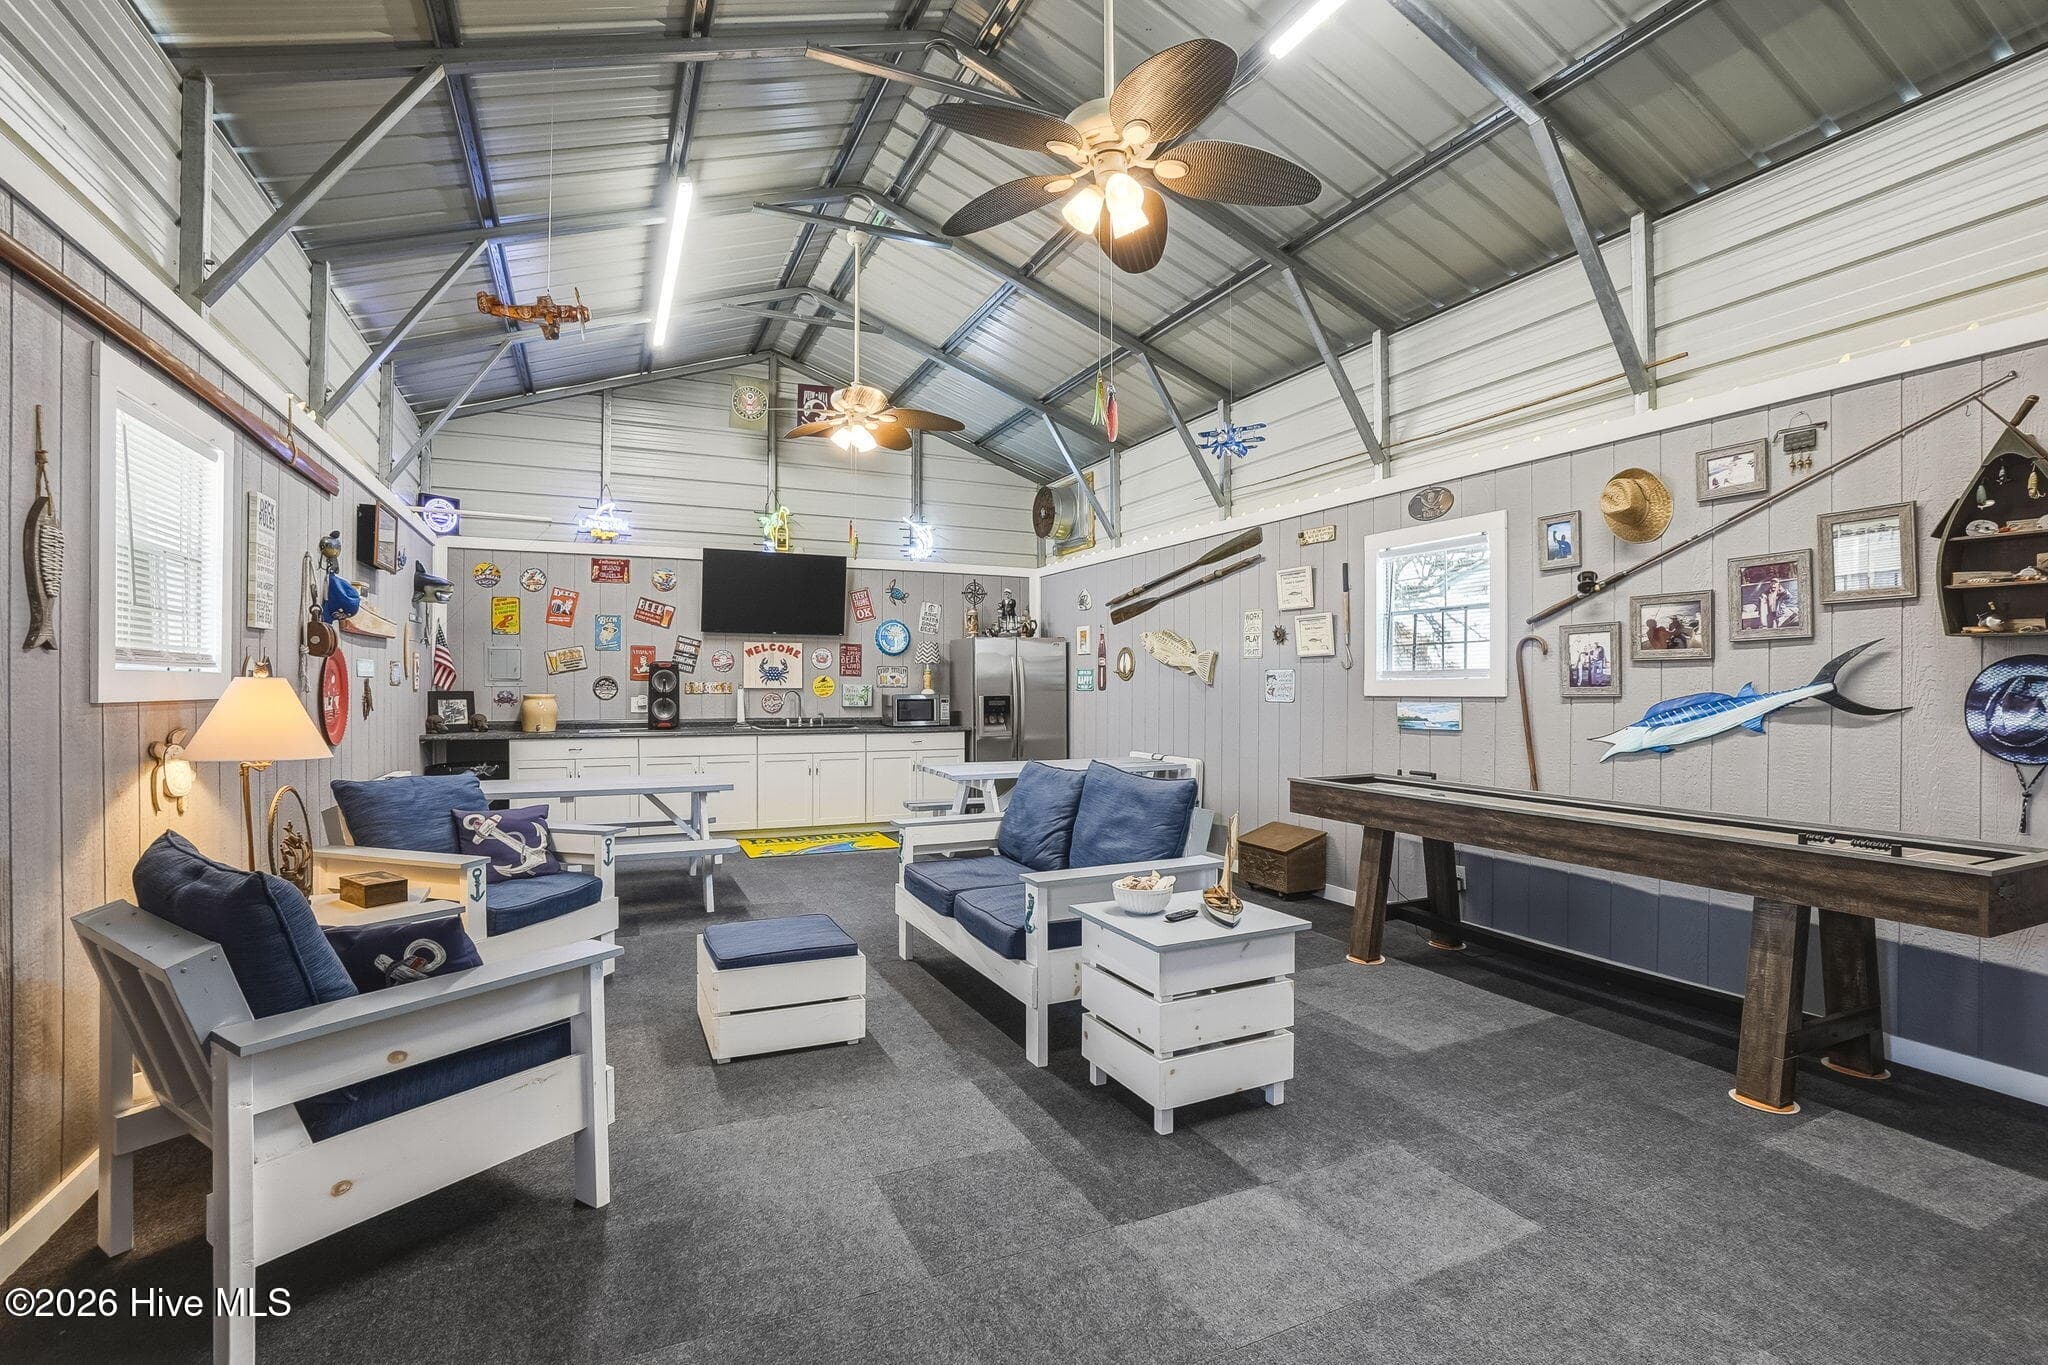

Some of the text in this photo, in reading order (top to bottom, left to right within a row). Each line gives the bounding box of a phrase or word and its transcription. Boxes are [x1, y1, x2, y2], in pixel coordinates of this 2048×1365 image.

[260, 498, 275, 515] DECK
[856, 607, 873, 619] OK
[744, 643, 802, 659] WELCOME
